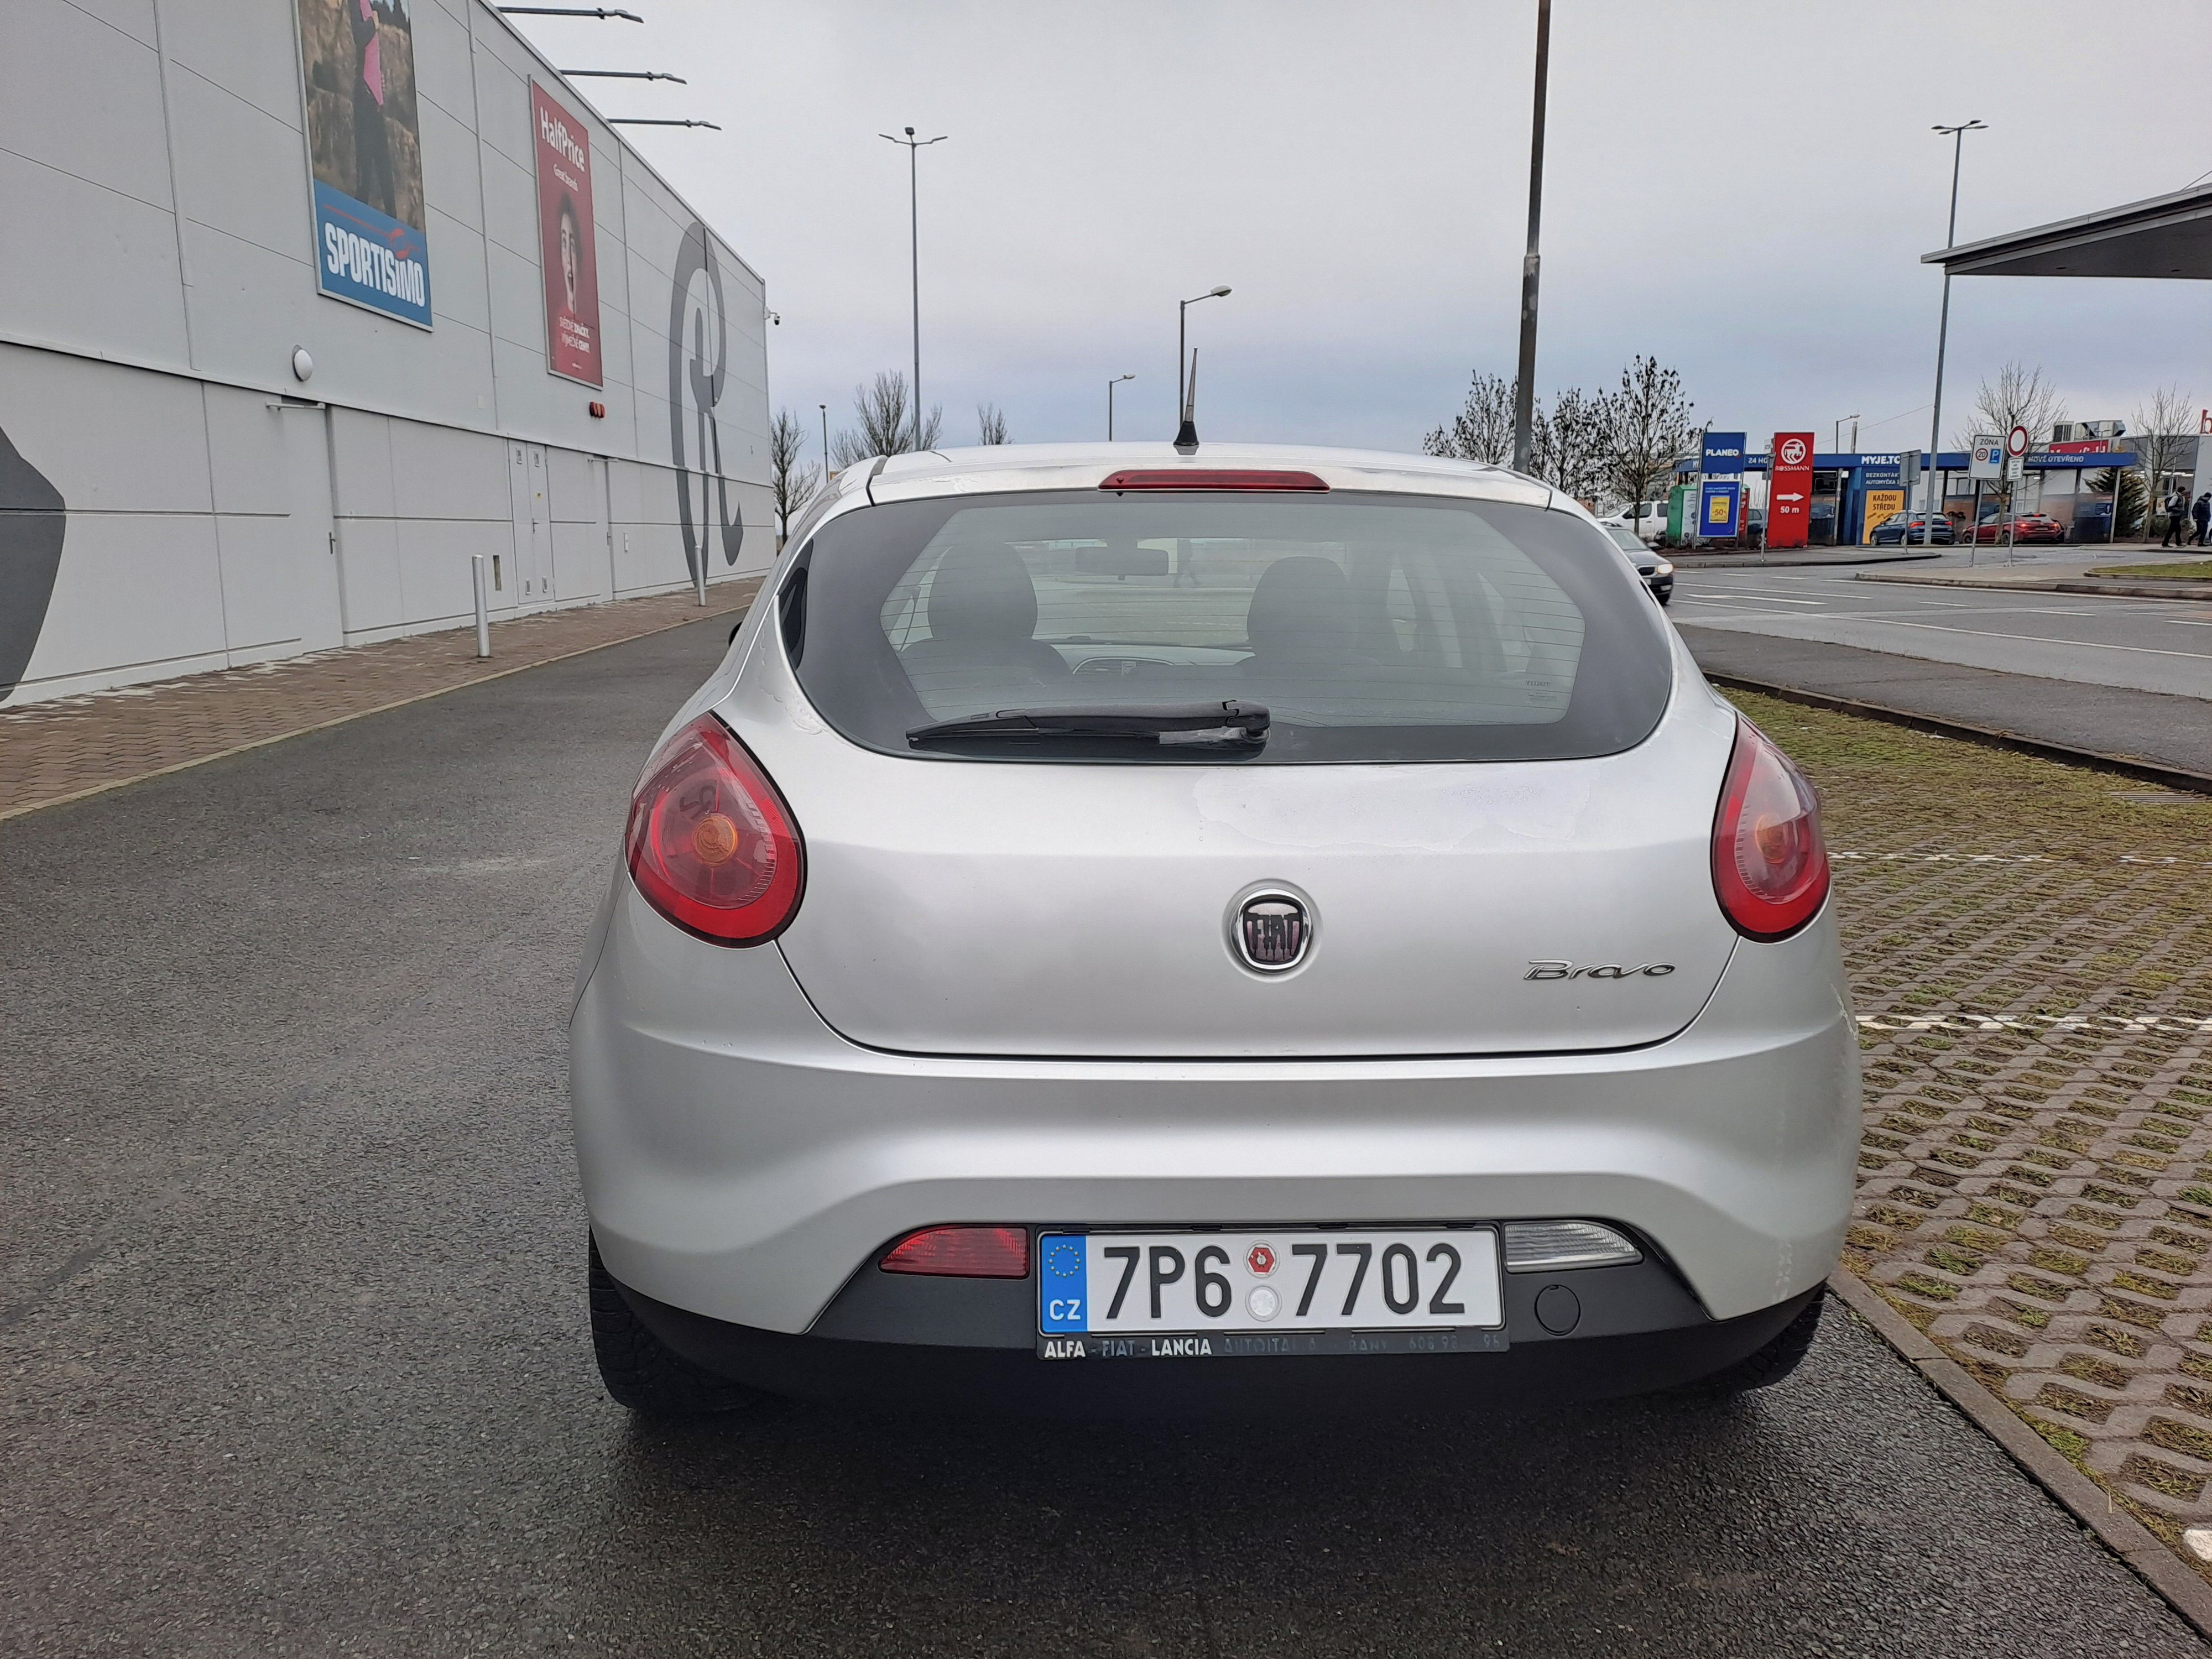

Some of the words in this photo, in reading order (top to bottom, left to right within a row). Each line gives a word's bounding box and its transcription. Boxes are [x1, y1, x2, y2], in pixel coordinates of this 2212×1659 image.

[540, 106, 585, 172] HalfPrice
[1244, 911, 1301, 952] FIAT
[1524, 959, 1676, 980] Bravo
[1103, 1244, 1233, 1319] 7P6
[1291, 1243, 1465, 1317] 7702
[1050, 1300, 1081, 1321] CZ
[1045, 1340, 1086, 1358] ALFA
[1102, 1340, 1134, 1357] FIAT
[1152, 1338, 1213, 1357] LANCIA
